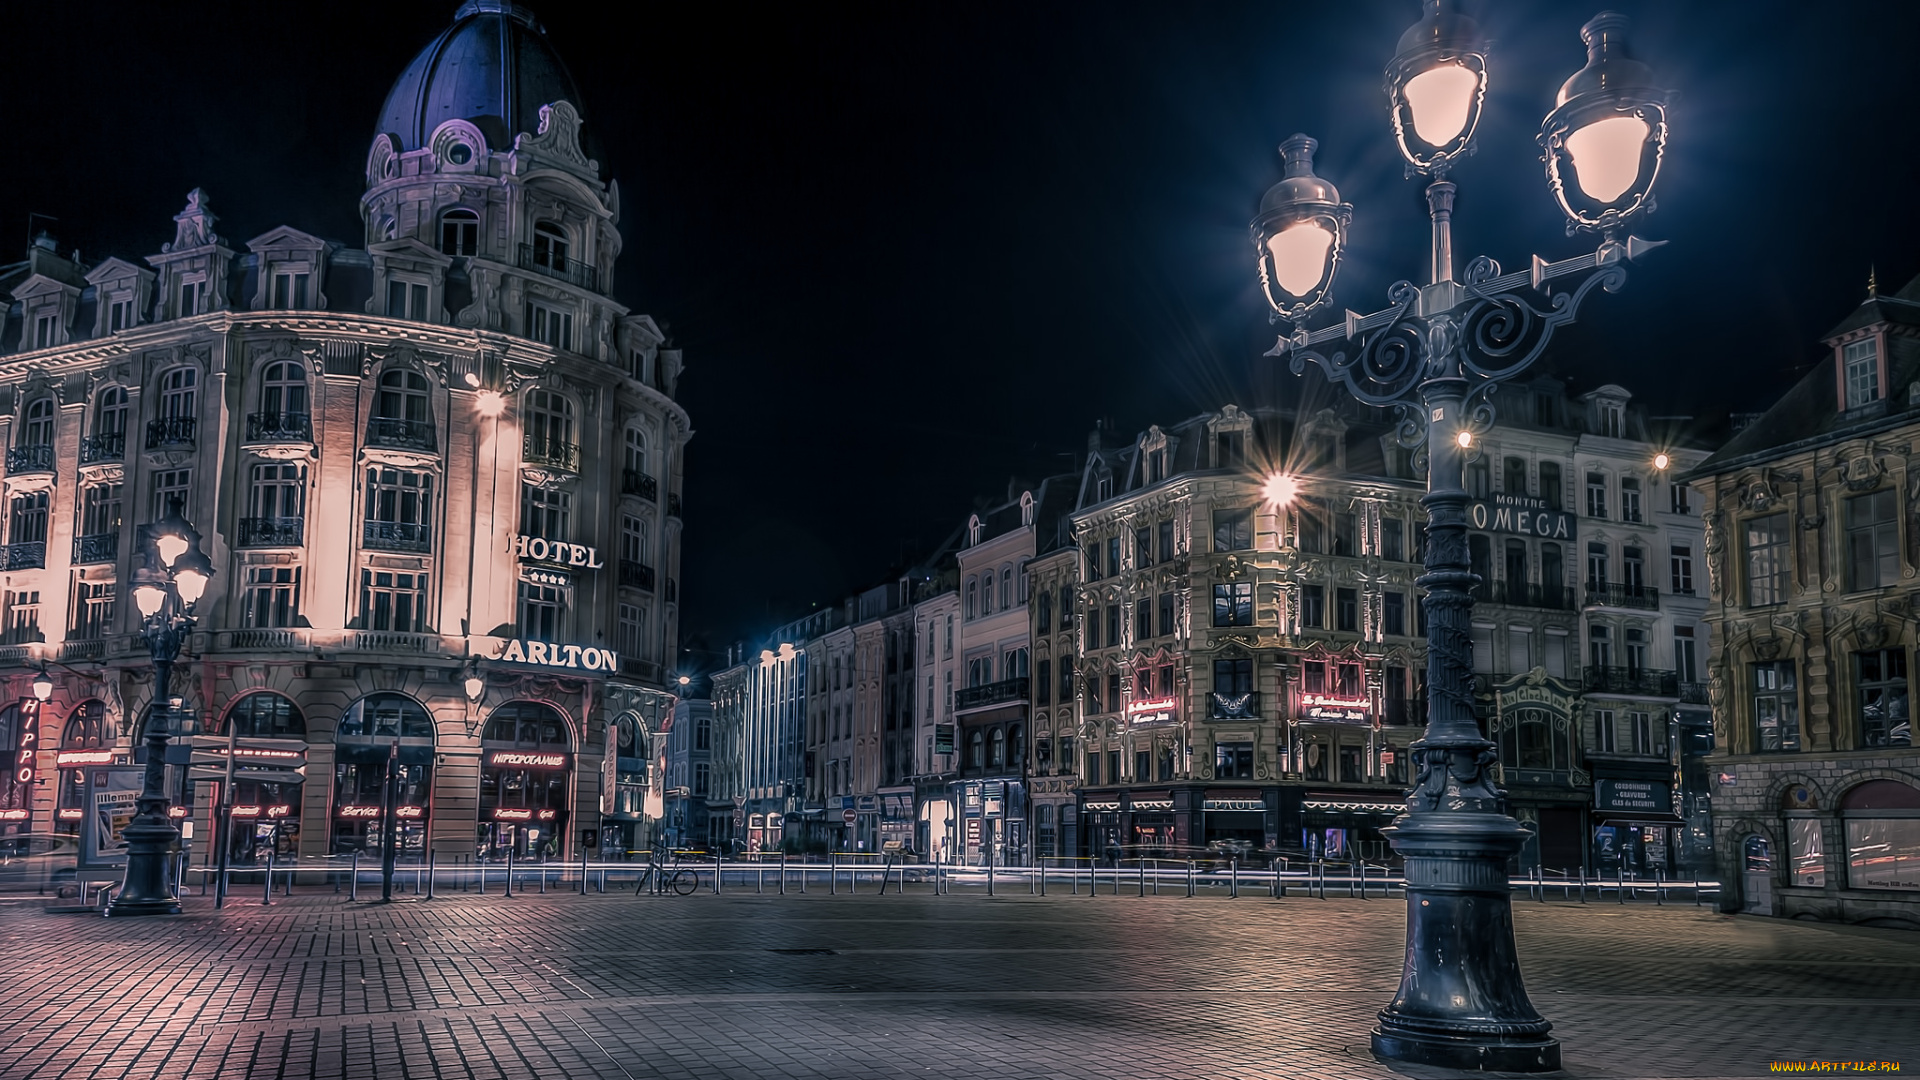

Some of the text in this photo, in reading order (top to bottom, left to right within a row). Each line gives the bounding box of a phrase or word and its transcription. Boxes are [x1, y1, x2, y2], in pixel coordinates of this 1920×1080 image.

[1496, 494, 1546, 509] MONTRE
[1472, 503, 1569, 538] OMEGA
[507, 533, 604, 569] HOTEL
[20, 699, 39, 782] HIPPO
[1614, 783, 1651, 791] CORDONNERIE
[342, 806, 378, 816] Service
[1214, 800, 1257, 810] PAUL
